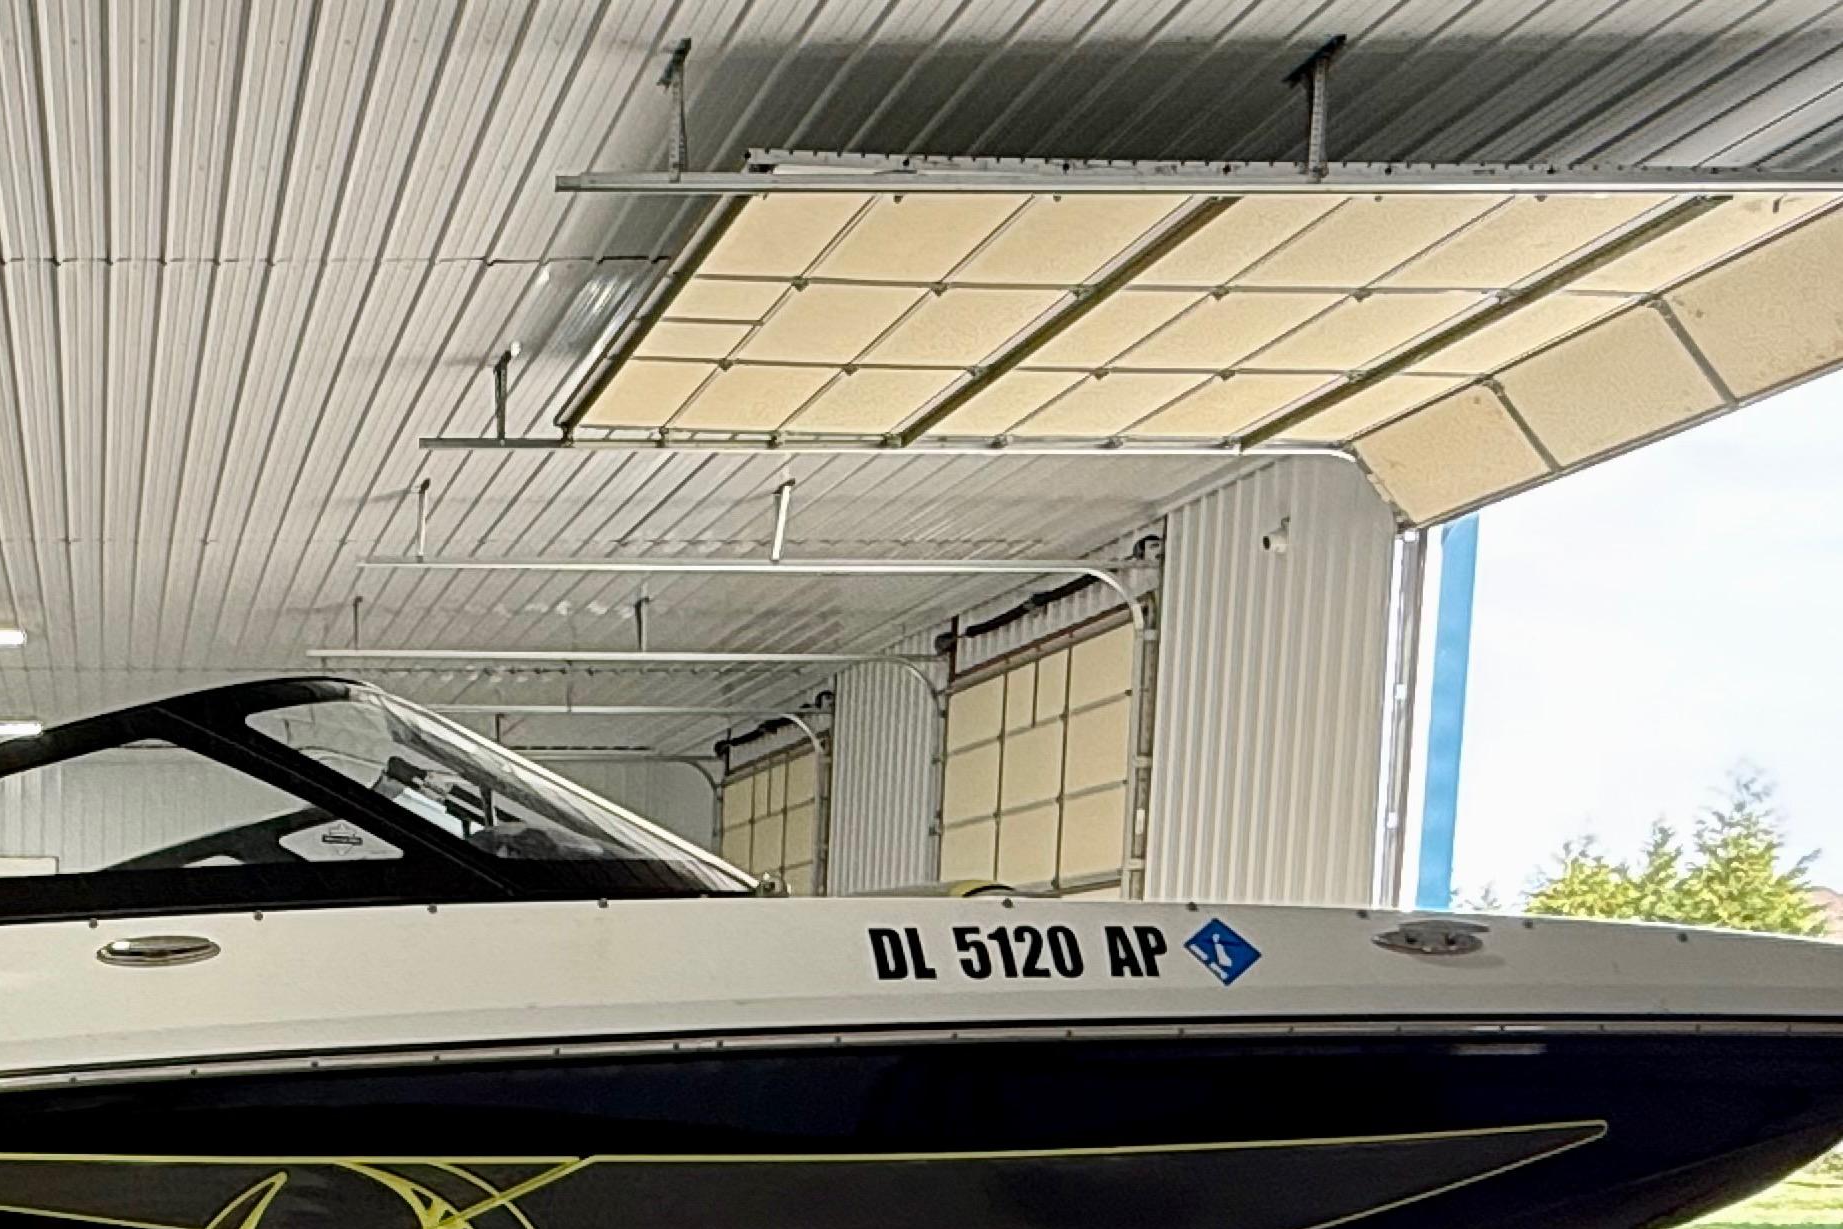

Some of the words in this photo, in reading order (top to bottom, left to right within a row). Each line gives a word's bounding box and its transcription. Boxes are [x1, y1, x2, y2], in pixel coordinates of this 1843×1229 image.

[868, 926, 937, 979] DL
[953, 926, 1084, 979] 5120
[1103, 926, 1168, 977] AP
